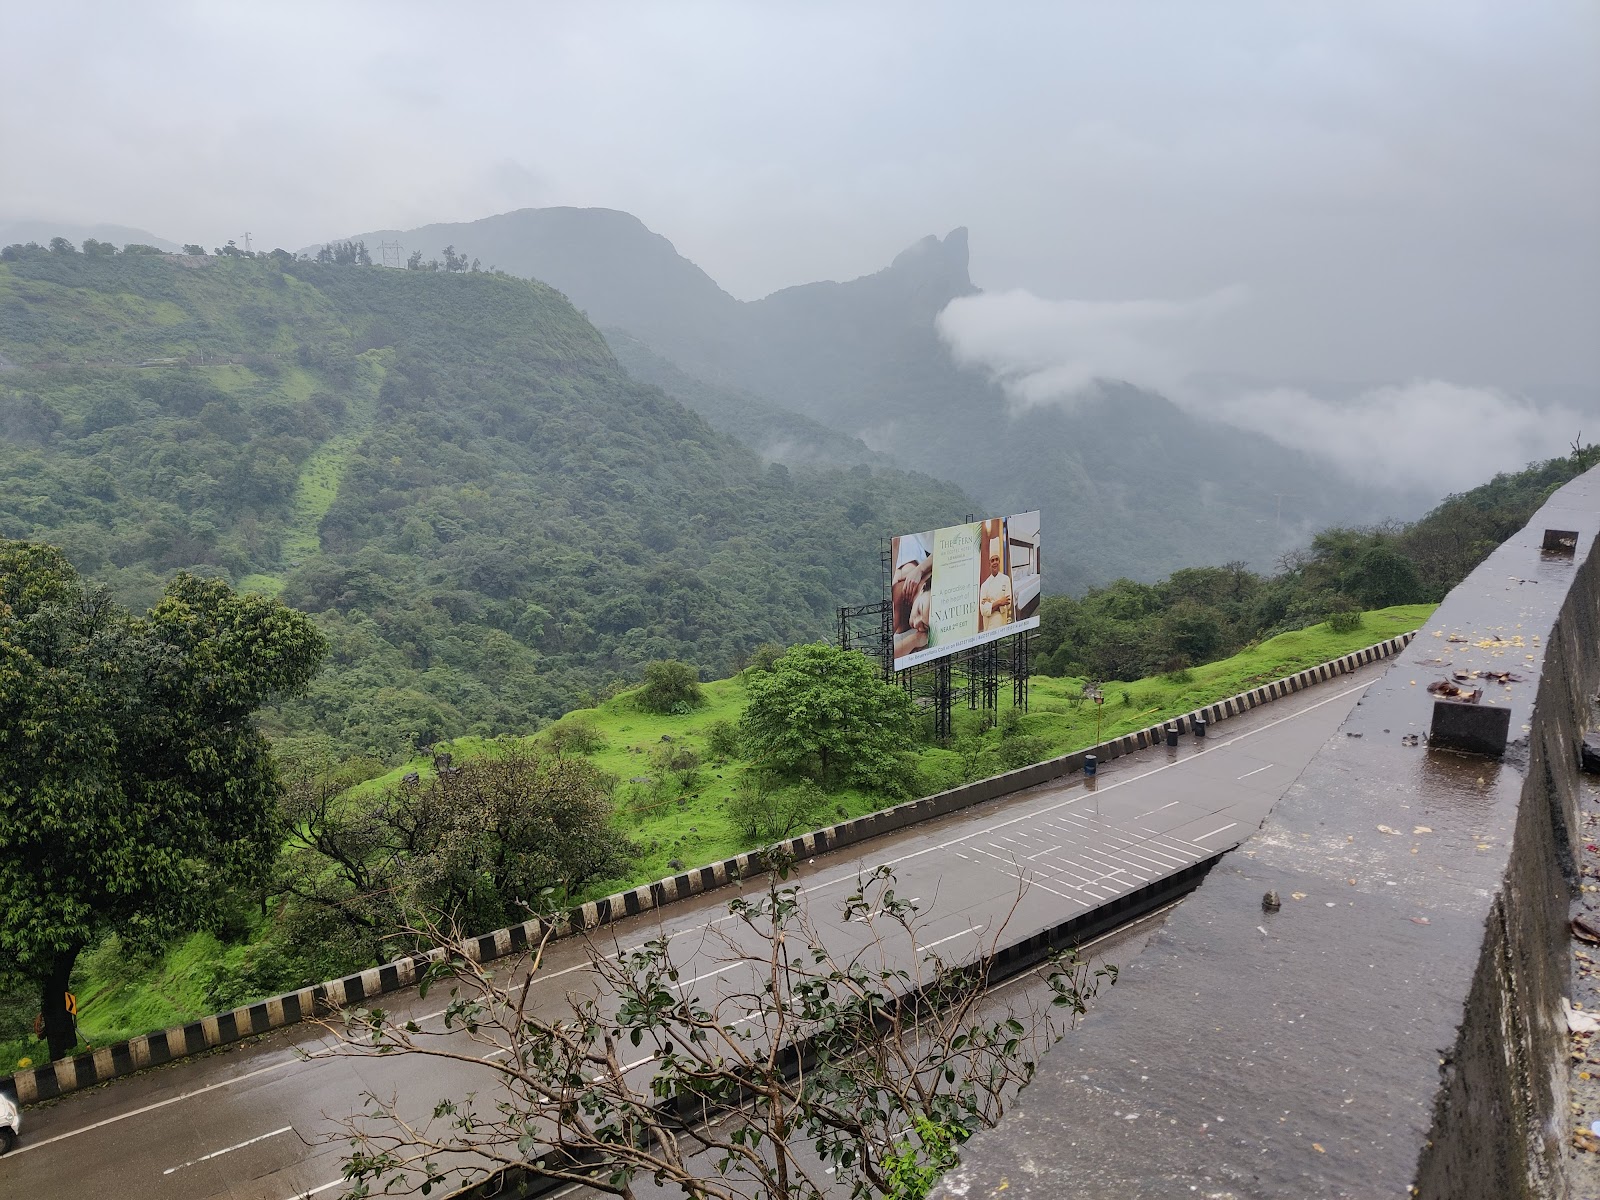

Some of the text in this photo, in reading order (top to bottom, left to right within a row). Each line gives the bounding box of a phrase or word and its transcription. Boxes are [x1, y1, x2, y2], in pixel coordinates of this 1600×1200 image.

[940, 536, 973, 549] THE FERN
[935, 601, 976, 623] NATURE
[941, 625, 952, 633] NEAR
[960, 620, 968, 628] EXIT
